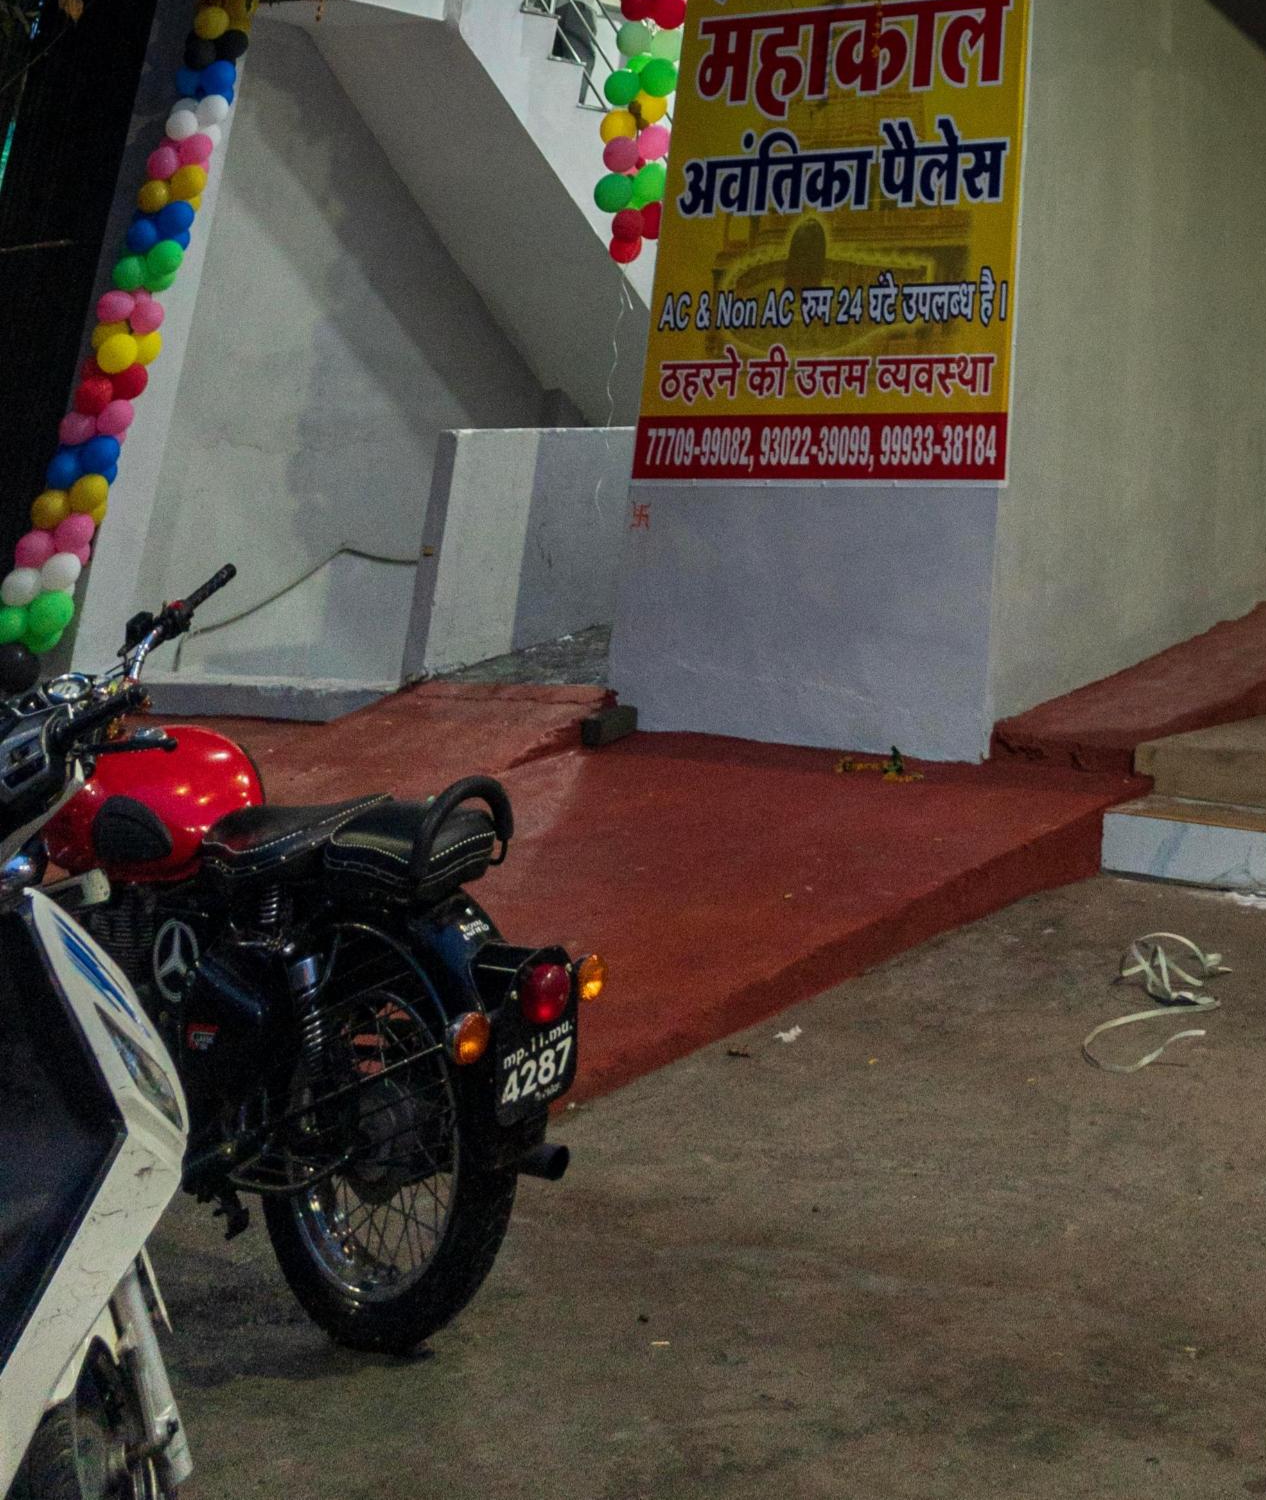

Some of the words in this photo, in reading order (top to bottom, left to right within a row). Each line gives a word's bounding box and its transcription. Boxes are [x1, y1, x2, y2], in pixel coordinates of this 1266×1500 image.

[677, 128, 877, 218] अवंतिका
[878, 114, 1011, 208] पैलेस
[658, 291, 692, 331] AC
[695, 291, 712, 330] &
[716, 290, 757, 330] Non
[761, 288, 795, 328] AC
[836, 287, 864, 325] 24
[868, 271, 898, 324] घंटे
[902, 281, 976, 324] उपलब्ध
[659, 345, 741, 405] ठहरने
[747, 343, 789, 398] की
[796, 355, 870, 398] उत्तम
[877, 352, 997, 398] व्यवस्था
[644, 426, 755, 472] 77709-99082,
[759, 425, 875, 472] 93022-39099,
[880, 424, 997, 466] 99933-38184
[501, 1036, 573, 1104] 4287
